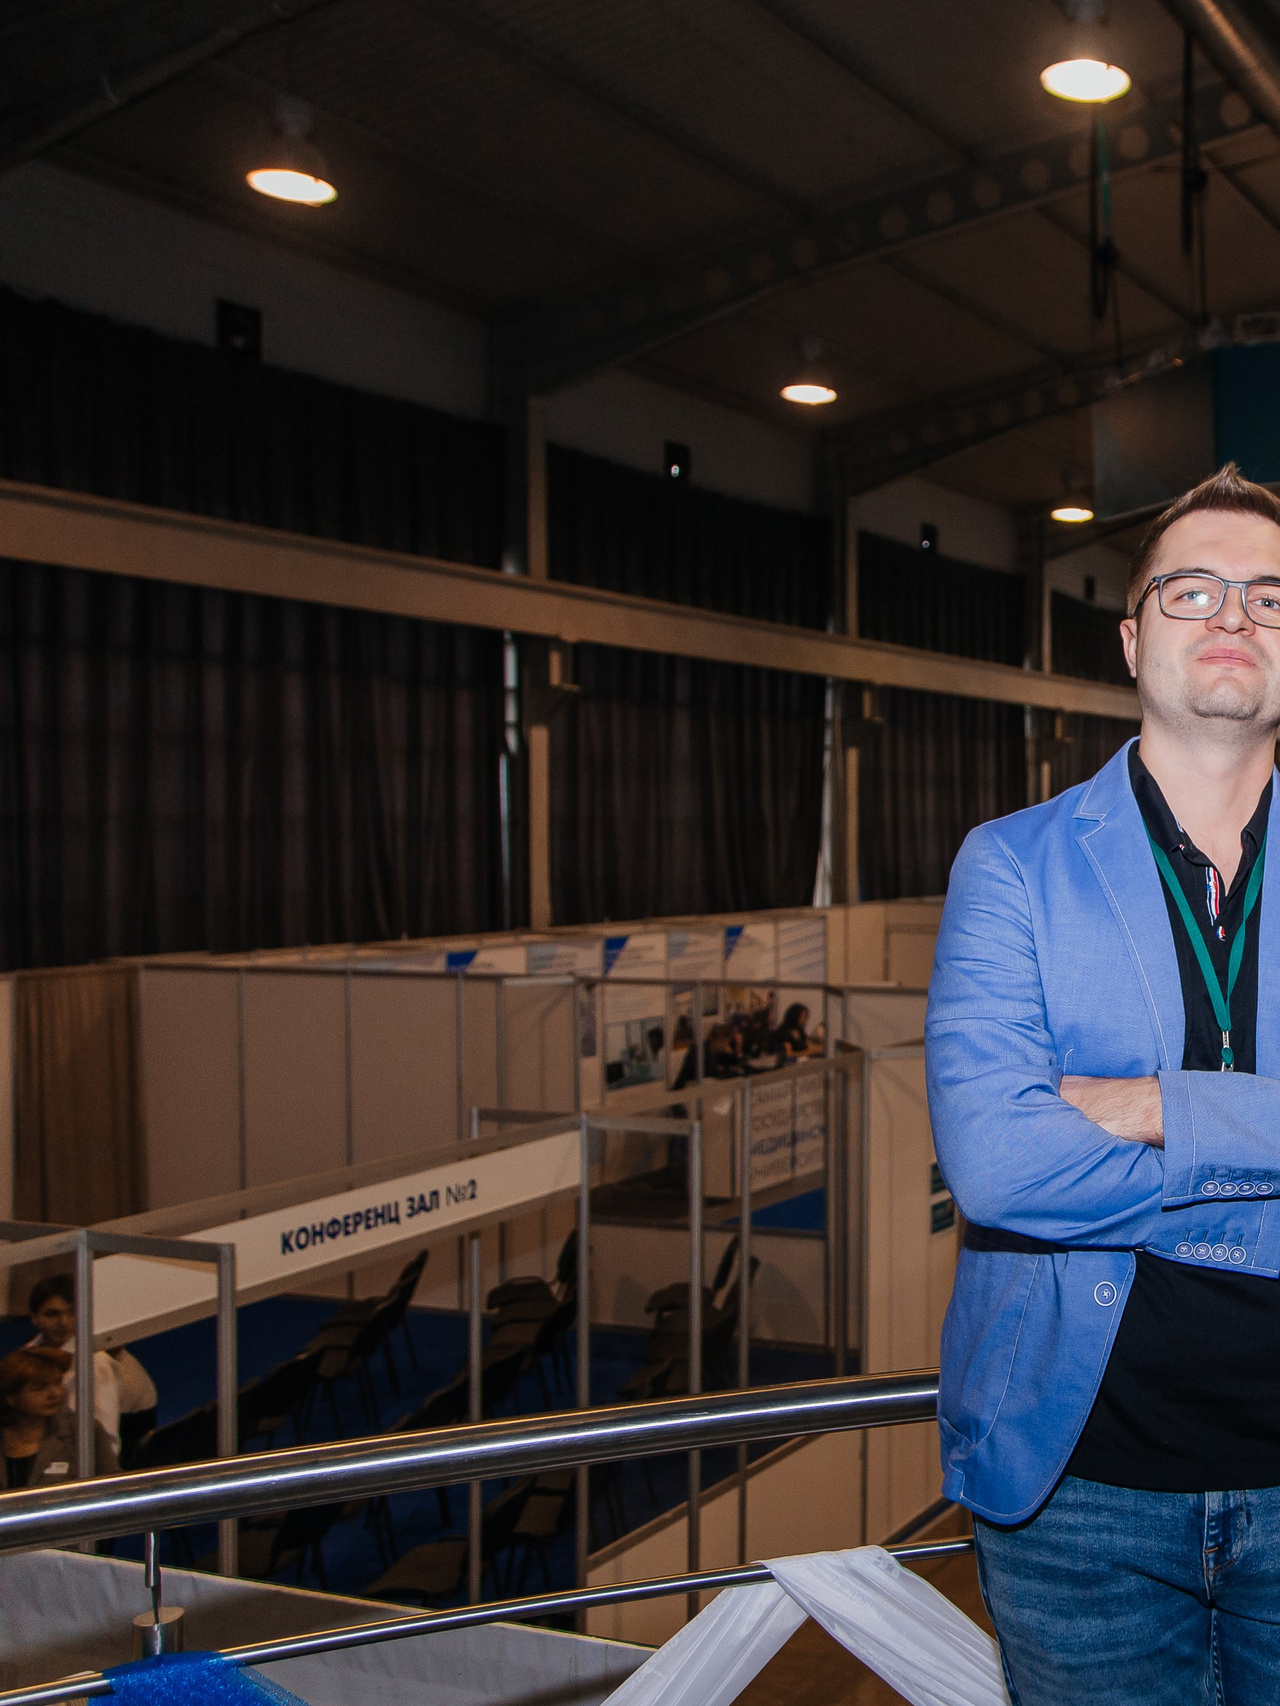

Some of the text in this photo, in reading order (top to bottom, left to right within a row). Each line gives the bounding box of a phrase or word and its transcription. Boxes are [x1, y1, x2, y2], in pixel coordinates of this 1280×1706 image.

[280, 1179, 478, 1255] КОНФЕРЕНЦ ЗАЛ №2
